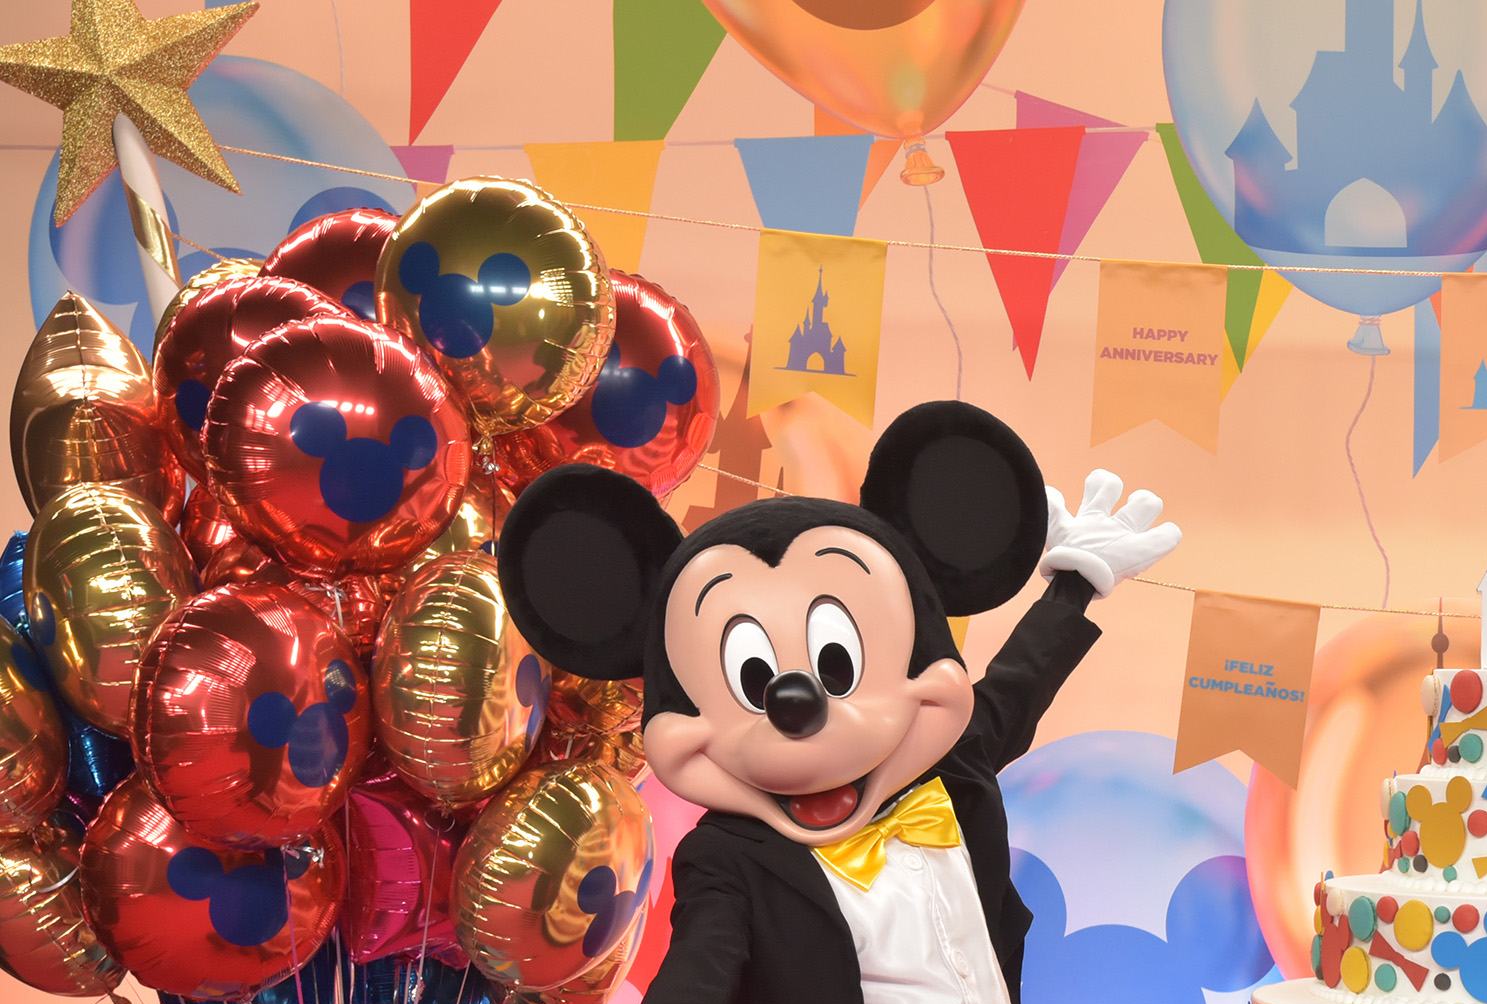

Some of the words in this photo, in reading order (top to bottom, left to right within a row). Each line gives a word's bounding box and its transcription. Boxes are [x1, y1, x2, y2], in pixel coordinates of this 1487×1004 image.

[1132, 327, 1188, 342] HAPPY
[1100, 346, 1218, 366] ANNIVERSARY
[1188, 676, 1305, 702] CUMPLEAÑOS!
